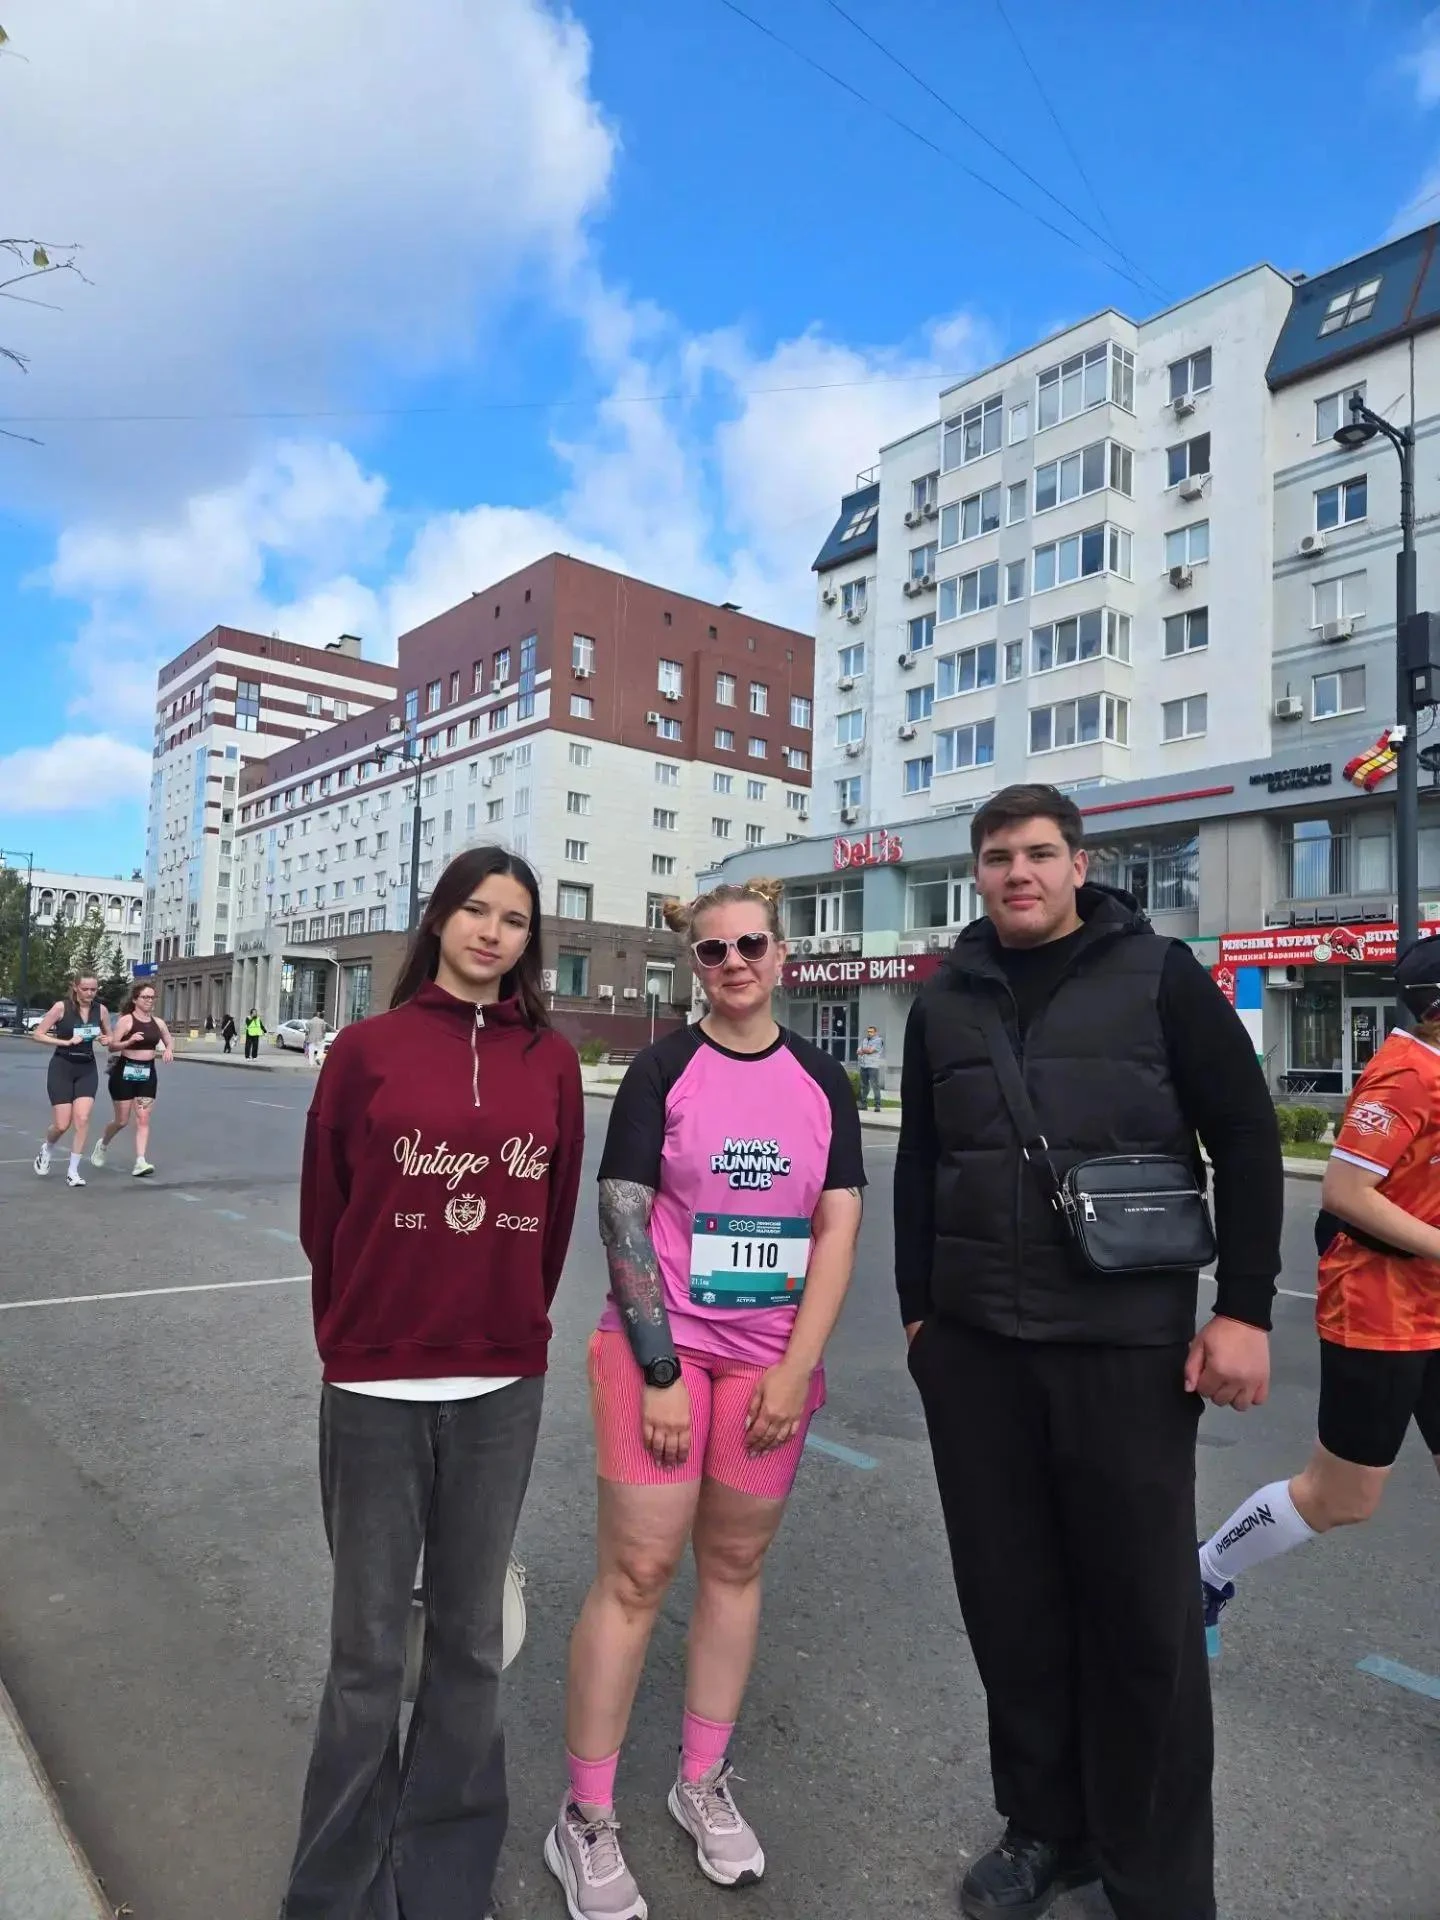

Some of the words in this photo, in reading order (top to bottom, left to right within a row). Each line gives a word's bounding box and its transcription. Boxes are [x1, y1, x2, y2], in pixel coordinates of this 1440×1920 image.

[1222, 937, 1274, 950] МЯСНИК
[1277, 934, 1321, 948] МУРАТ
[800, 961, 866, 982] МАСТЕР
[870, 958, 906, 979] ВИН
[723, 1137, 780, 1155] MYASS
[393, 1128, 490, 1191] Vintage
[710, 1154, 791, 1175] RUNNING
[728, 1171, 774, 1190] CLUB
[395, 1212, 427, 1229] EST.
[496, 1213, 539, 1232] 2022
[731, 1241, 778, 1268] 1110
[1215, 1511, 1261, 1556] NORDSKI
